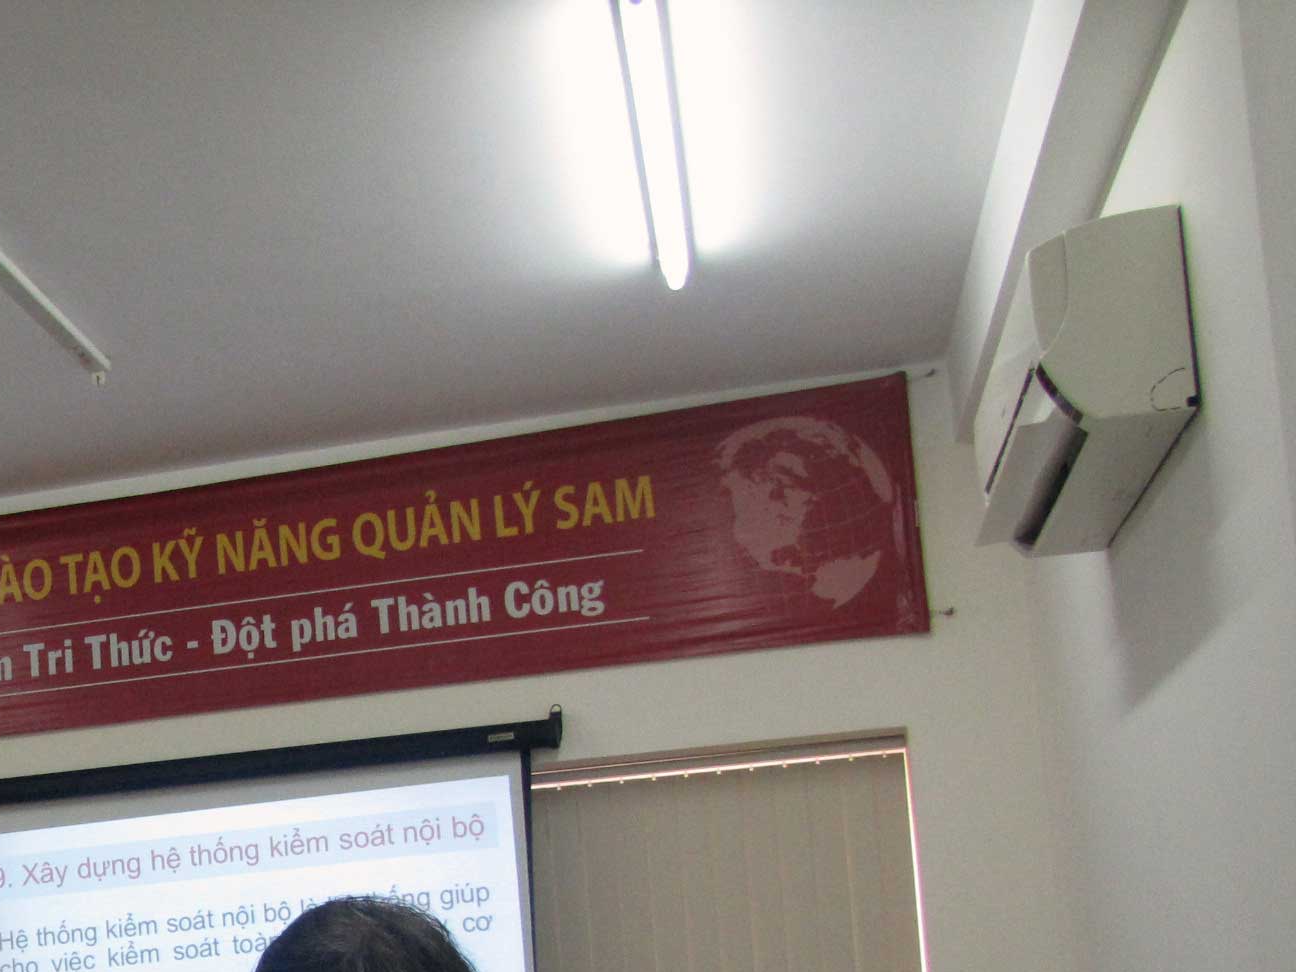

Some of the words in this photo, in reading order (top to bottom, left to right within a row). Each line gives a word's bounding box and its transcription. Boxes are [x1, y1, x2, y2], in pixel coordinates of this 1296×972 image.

[60, 546, 142, 604] TẠO
[152, 526, 203, 585] KỸ
[216, 517, 342, 575] NĂNG
[352, 490, 482, 560] QUẢN
[493, 481, 541, 538] LÝ
[555, 475, 657, 531] SAM
[24, 638, 74, 679] Tri
[84, 629, 174, 671] Thức
[210, 616, 277, 660] Đột
[290, 603, 359, 653] phá
[371, 588, 492, 636] Thành
[504, 579, 606, 622] Công
[22, 860, 68, 888] Xây
[77, 853, 142, 882] dựng
[151, 847, 182, 873] hệ
[189, 837, 260, 869] thống
[269, 826, 330, 859] kiểm
[338, 823, 396, 853] soát
[402, 817, 443, 849] nội
[452, 814, 486, 843] bộ
[36, 917, 98, 951] thống
[105, 911, 159, 940] kiểm
[166, 907, 215, 934] soát
[222, 903, 257, 930] nội
[264, 899, 292, 926] bộ
[440, 883, 491, 911] giúp
[107, 939, 161, 968] kiểm
[173, 934, 220, 961] soát
